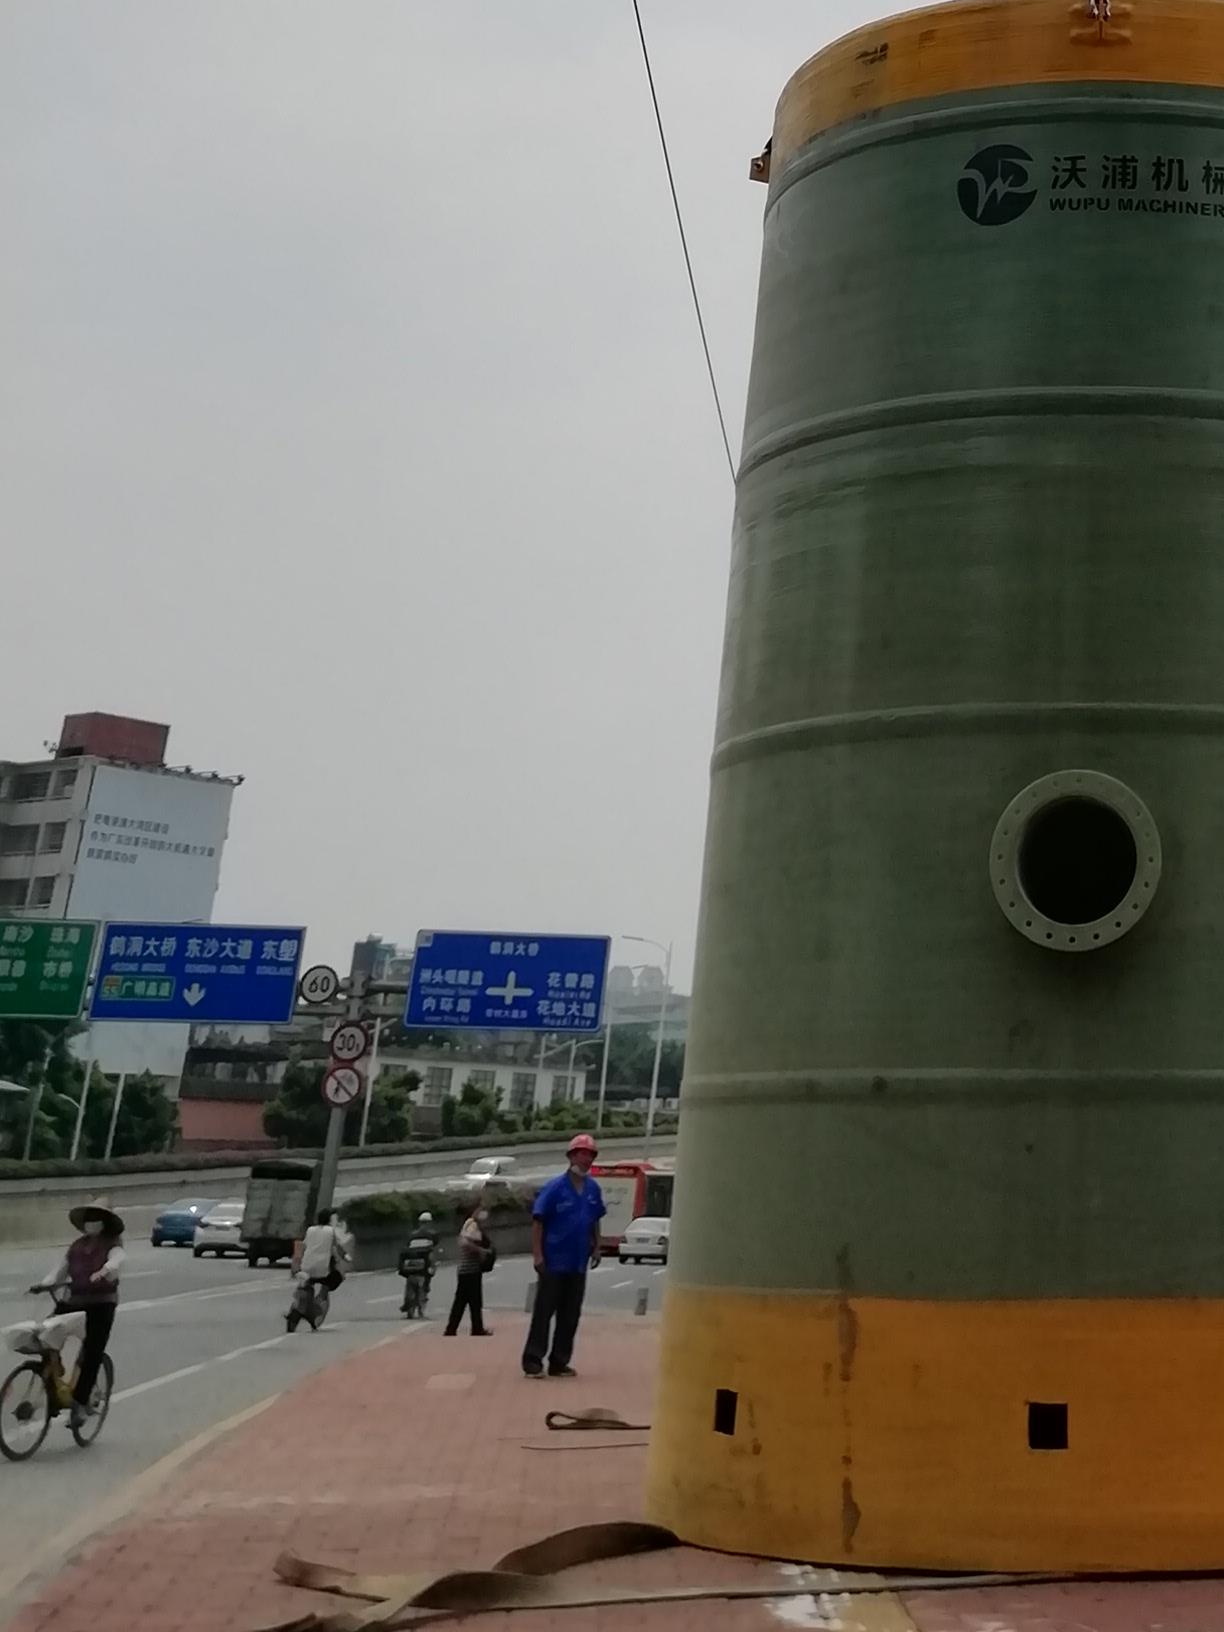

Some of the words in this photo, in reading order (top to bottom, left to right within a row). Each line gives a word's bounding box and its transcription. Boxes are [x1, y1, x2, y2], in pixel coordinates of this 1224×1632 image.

[1050, 197, 1110, 212] WUPU
[109, 935, 177, 957] 鹤洞大桥
[185, 937, 253, 959] 东沙大道
[308, 975, 330, 993] 60
[422, 996, 472, 1013] 内环路
[536, 999, 597, 1018] 花地大道
